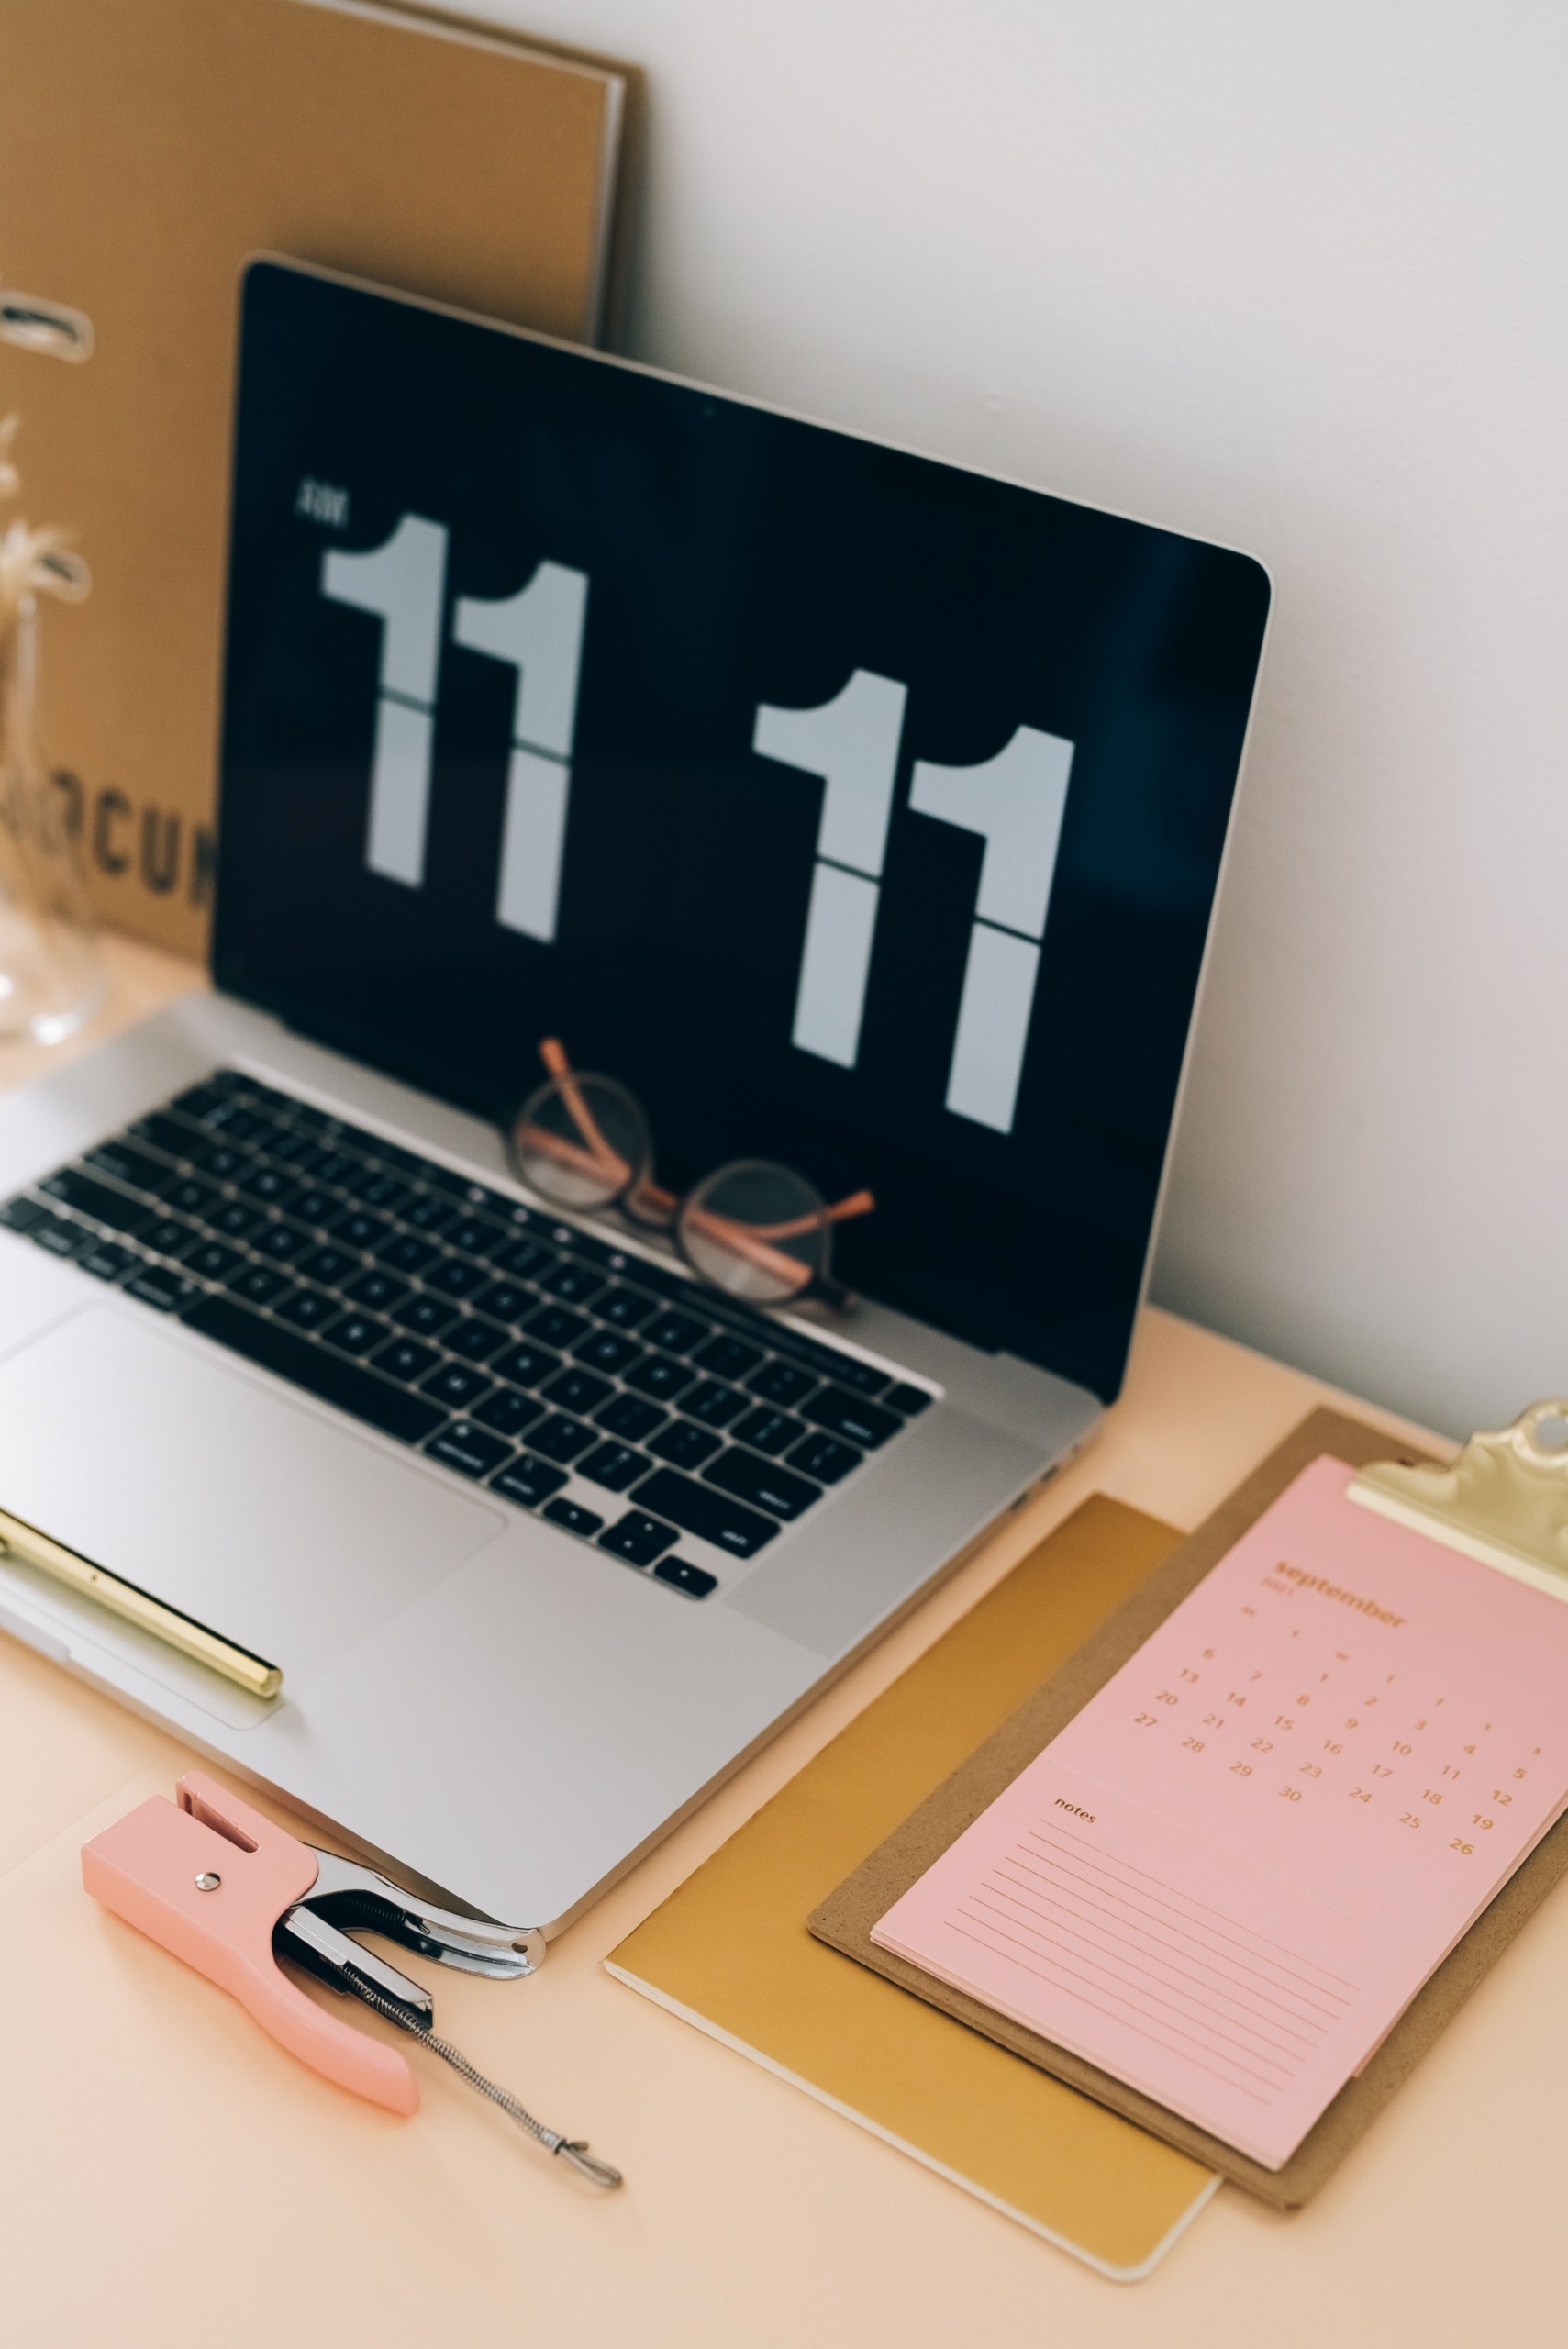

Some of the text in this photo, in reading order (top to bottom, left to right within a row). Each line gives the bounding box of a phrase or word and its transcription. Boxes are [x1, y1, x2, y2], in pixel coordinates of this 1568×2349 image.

[321, 513, 1075, 1135] 11 11
[1273, 1560, 1407, 1630] september
[1133, 1711, 1303, 1803] 27 28 29 30
[1154, 1689, 1475, 1856] 20 21 22 23 24 25 26
[1179, 1667, 1496, 1831] 13 14 15 16 17 18 19
[1202, 1647, 1514, 1808] 6 7 8 9 10 11 12
[1319, 1671, 1528, 1781] 1 2 3 4 5
[1053, 1798, 1097, 1824] notes
